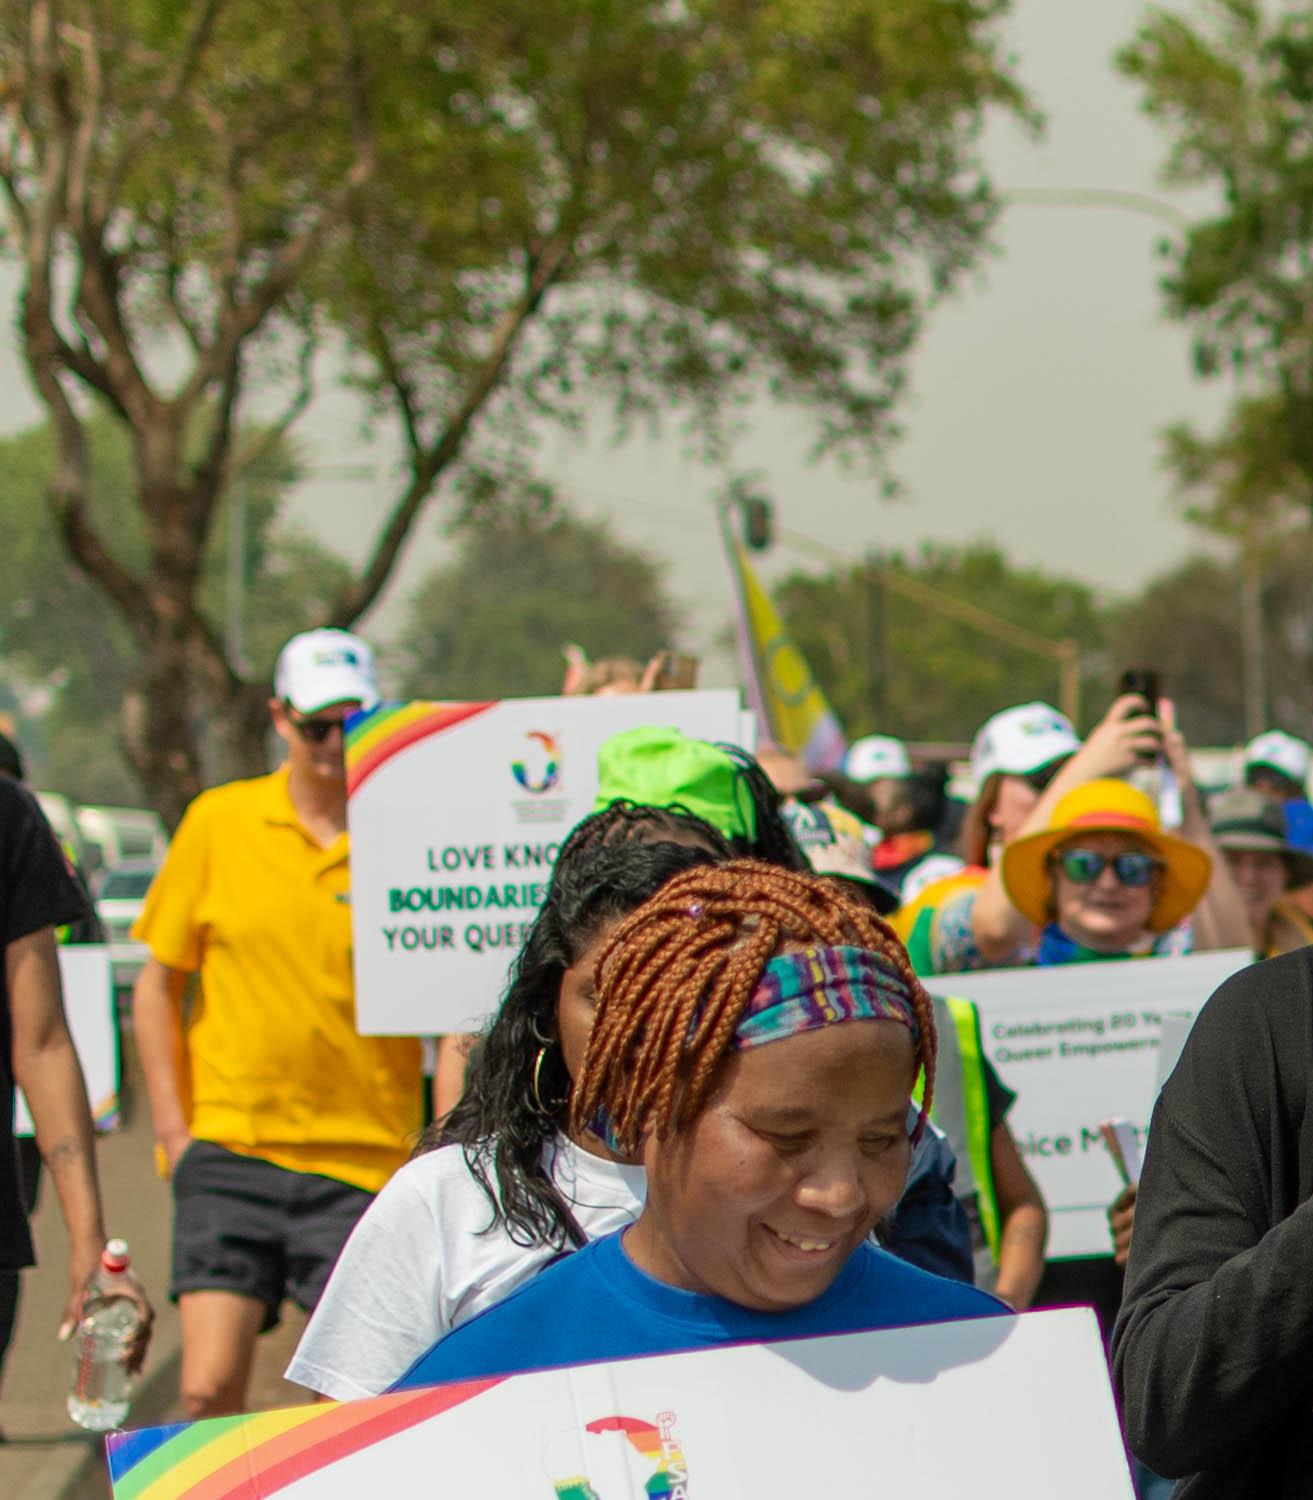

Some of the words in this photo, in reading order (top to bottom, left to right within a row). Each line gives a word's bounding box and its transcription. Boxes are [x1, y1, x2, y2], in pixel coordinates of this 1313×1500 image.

[427, 844, 496, 871] LOVE
[504, 843, 560, 868] KNO
[388, 883, 549, 912] BOUNDARIE
[382, 924, 455, 950] YOUR
[464, 923, 530, 952] QUEE
[992, 1016, 1105, 1039] Celebrating
[1110, 1013, 1136, 1030] 20
[994, 1045, 1052, 1063] Queer
[1059, 1037, 1160, 1057] Empowerm
[1016, 1131, 1072, 1156] oice
